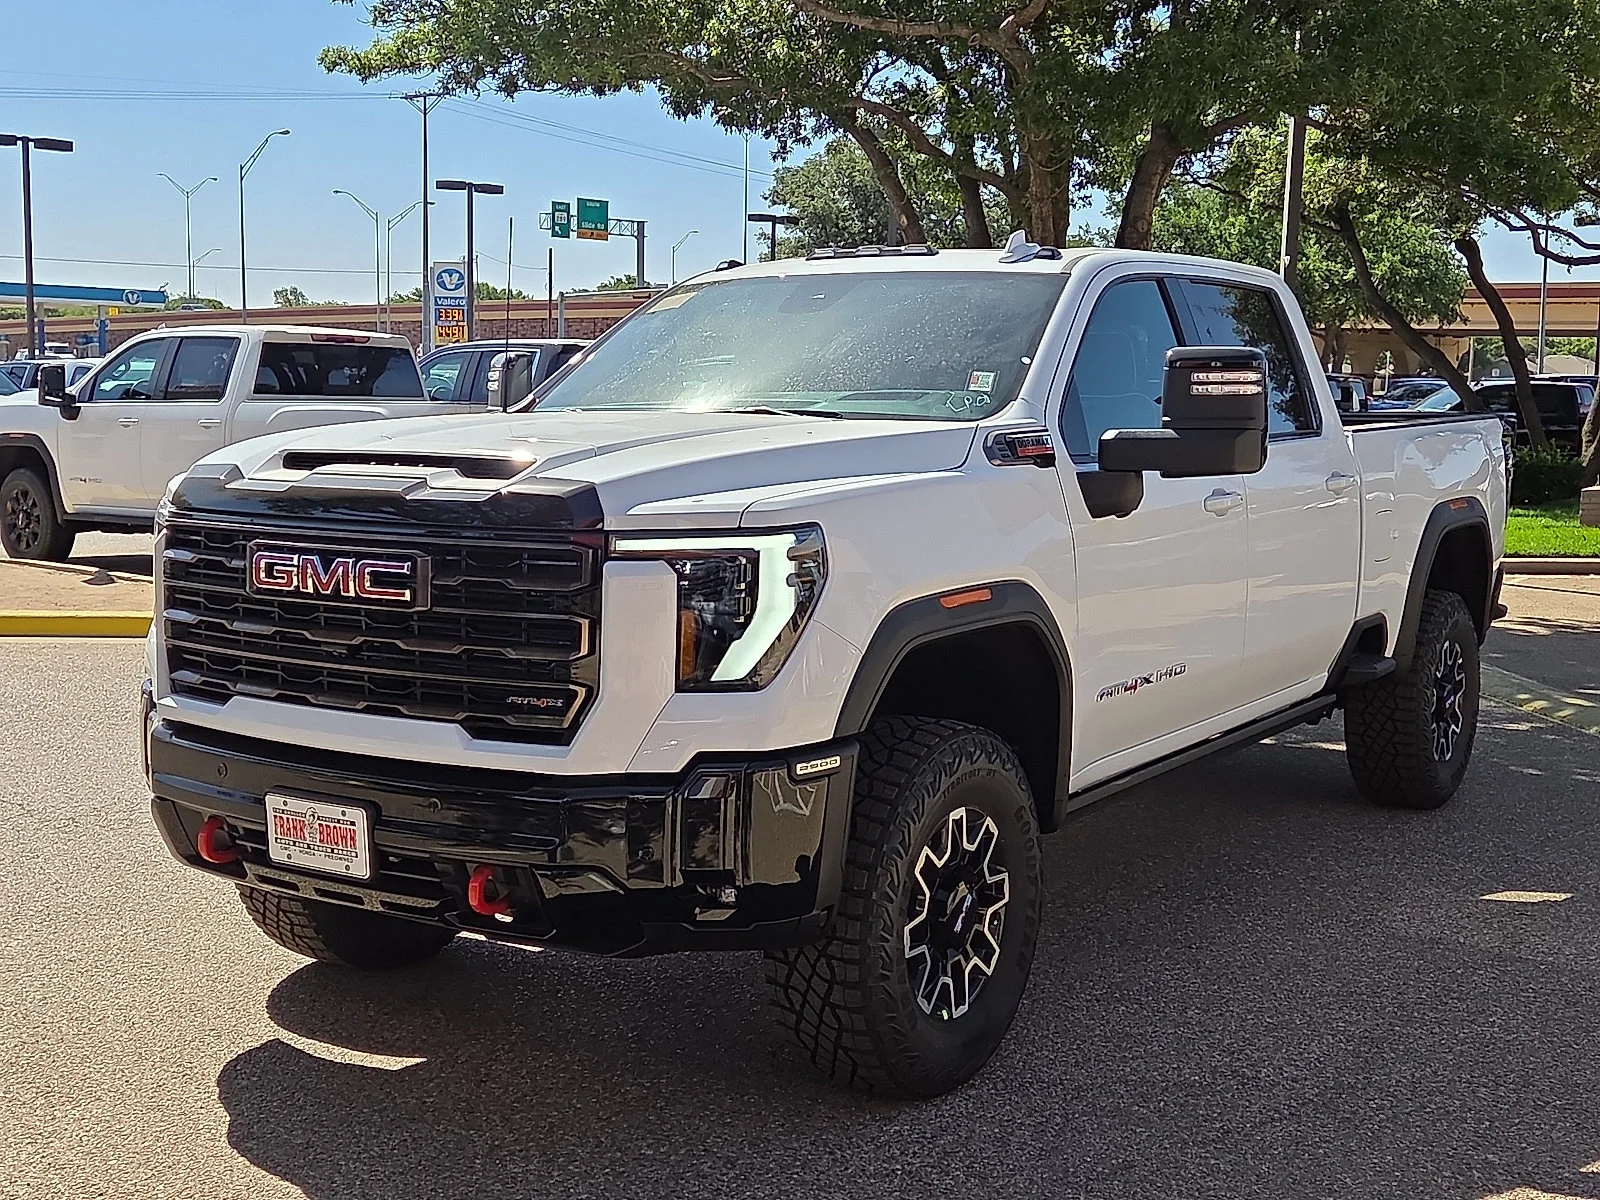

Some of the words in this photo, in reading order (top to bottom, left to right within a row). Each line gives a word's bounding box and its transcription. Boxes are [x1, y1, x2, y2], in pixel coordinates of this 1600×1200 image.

[436, 297, 466, 306] Valero
[1017, 436, 1051, 448] DURAMAX
[252, 551, 412, 602] GMC
[273, 815, 308, 842] FRANK
[317, 822, 358, 851] BROWN
